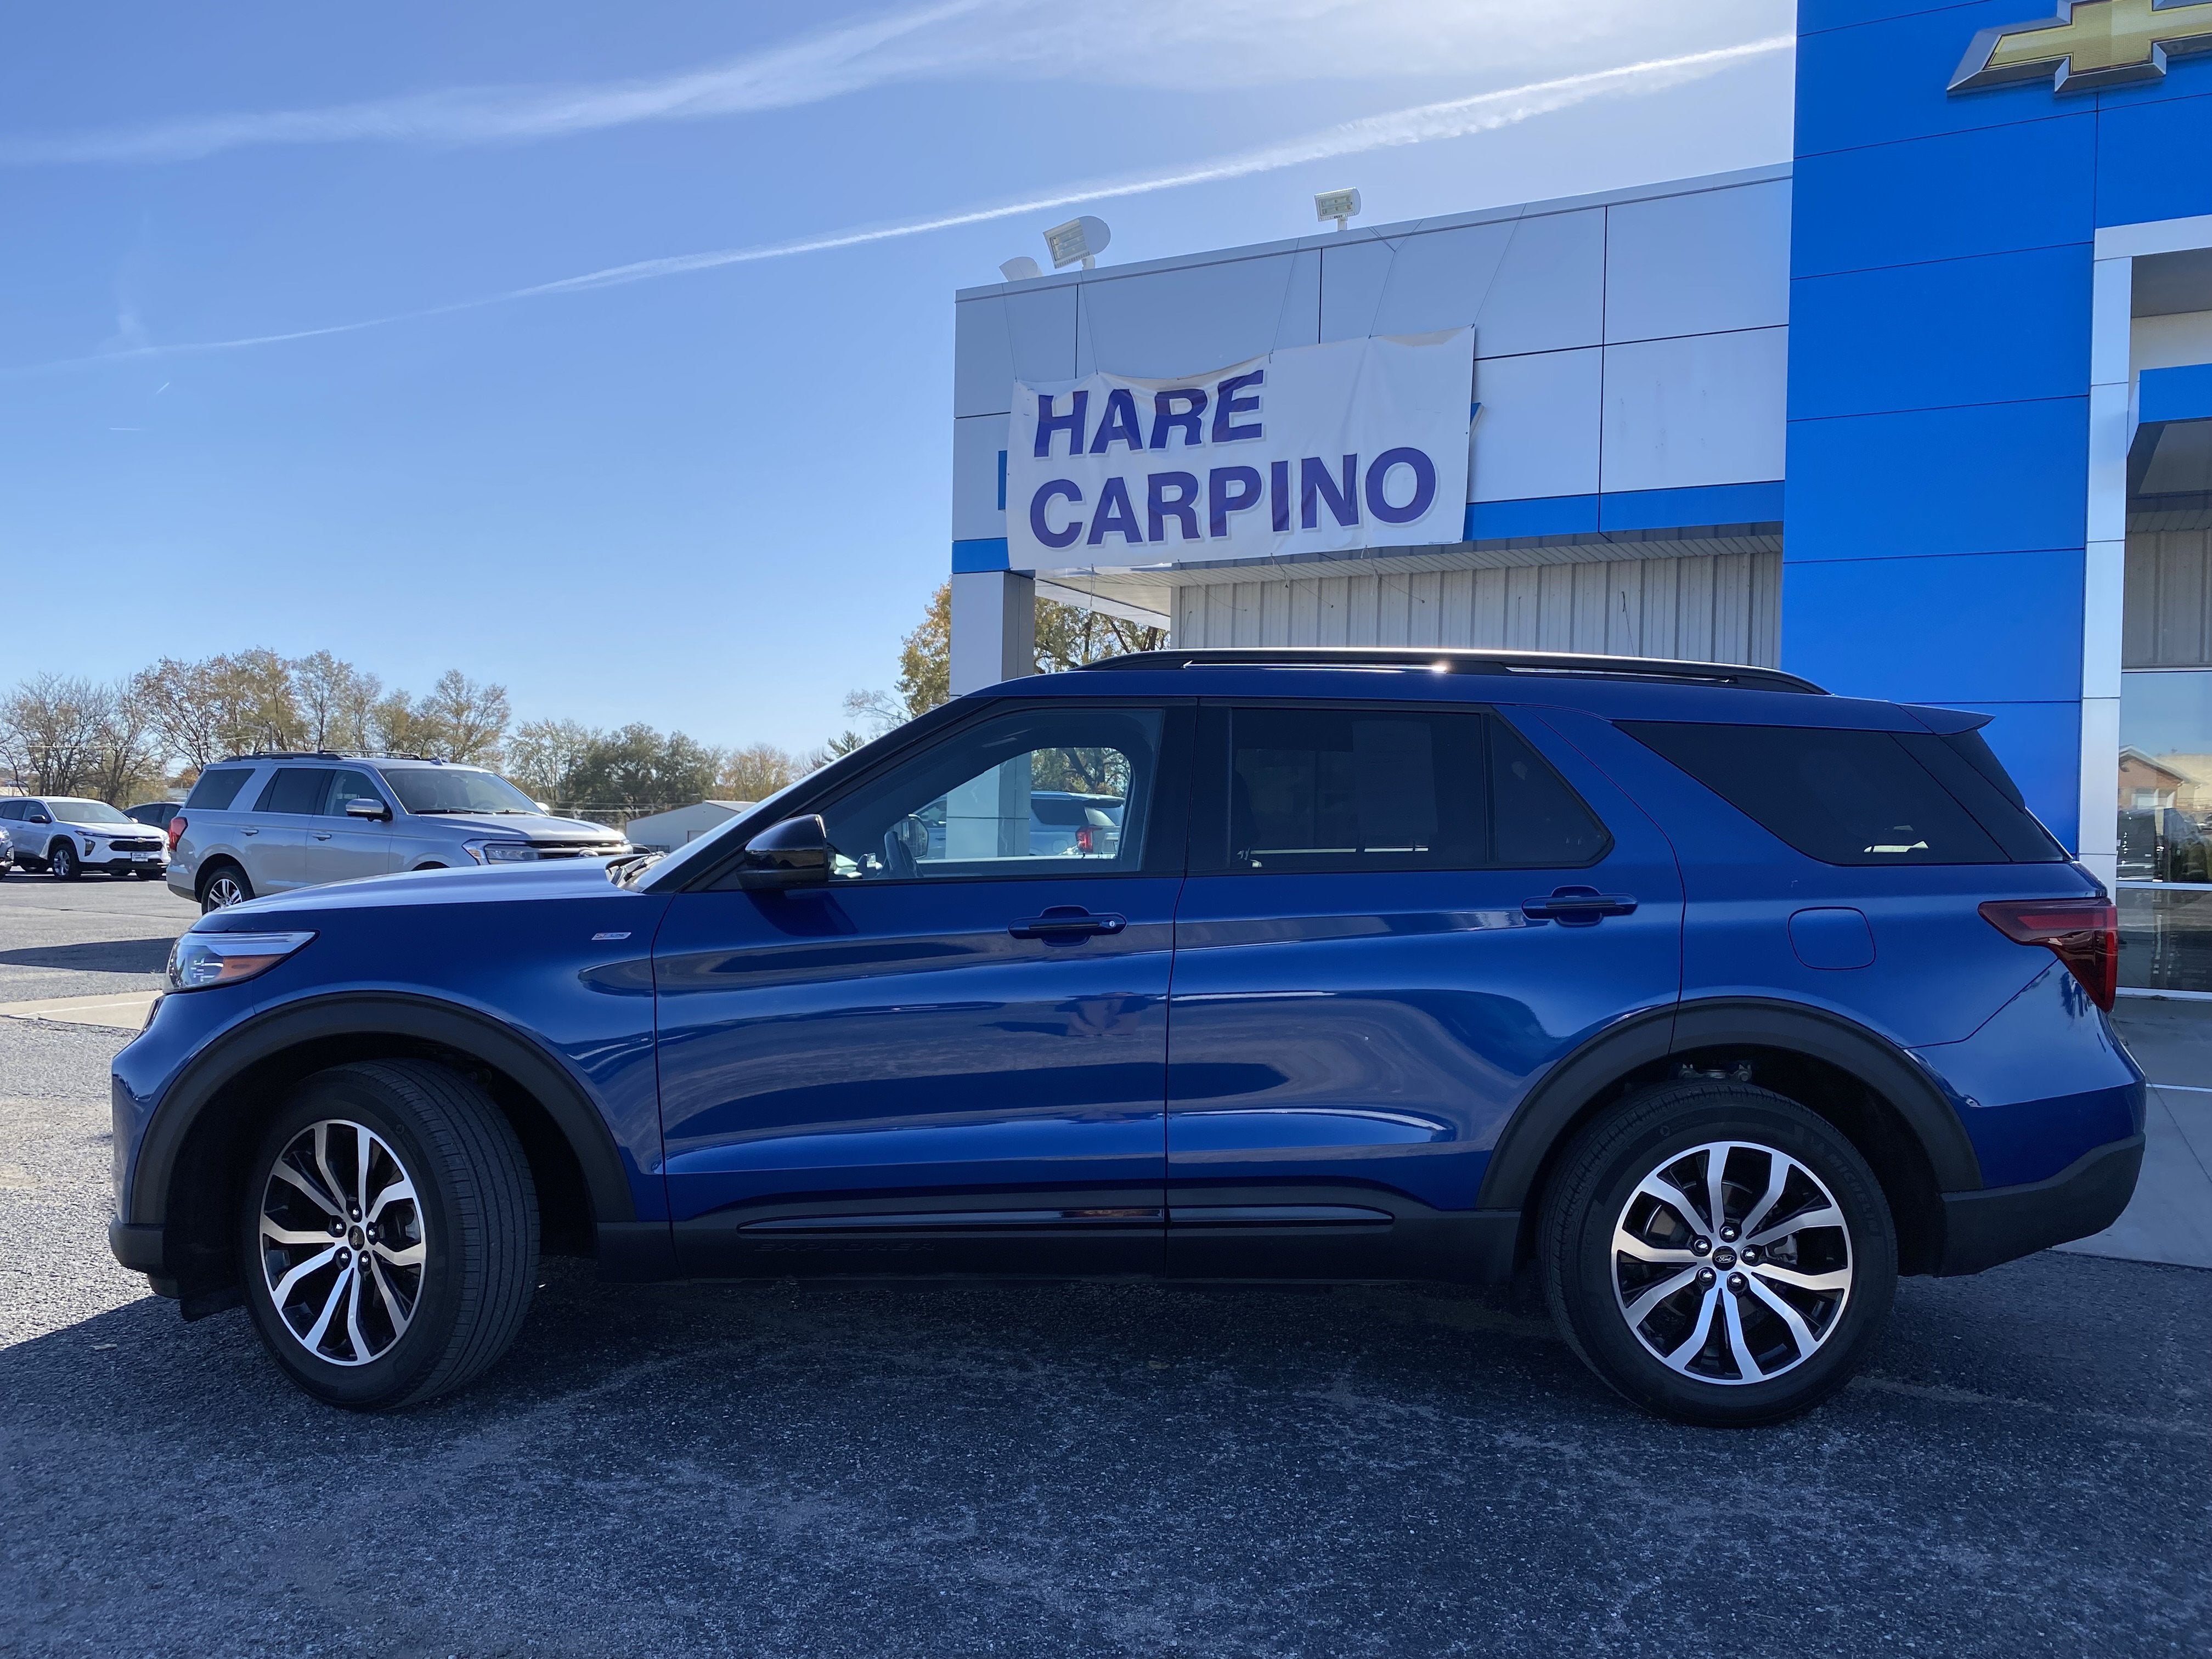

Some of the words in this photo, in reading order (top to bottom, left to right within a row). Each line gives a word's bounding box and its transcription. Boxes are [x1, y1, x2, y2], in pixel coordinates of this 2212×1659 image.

[1034, 369, 1264, 458] HARE
[1029, 447, 1436, 548] CARPINO
[1826, 1153, 1879, 1233] MICHELIN
